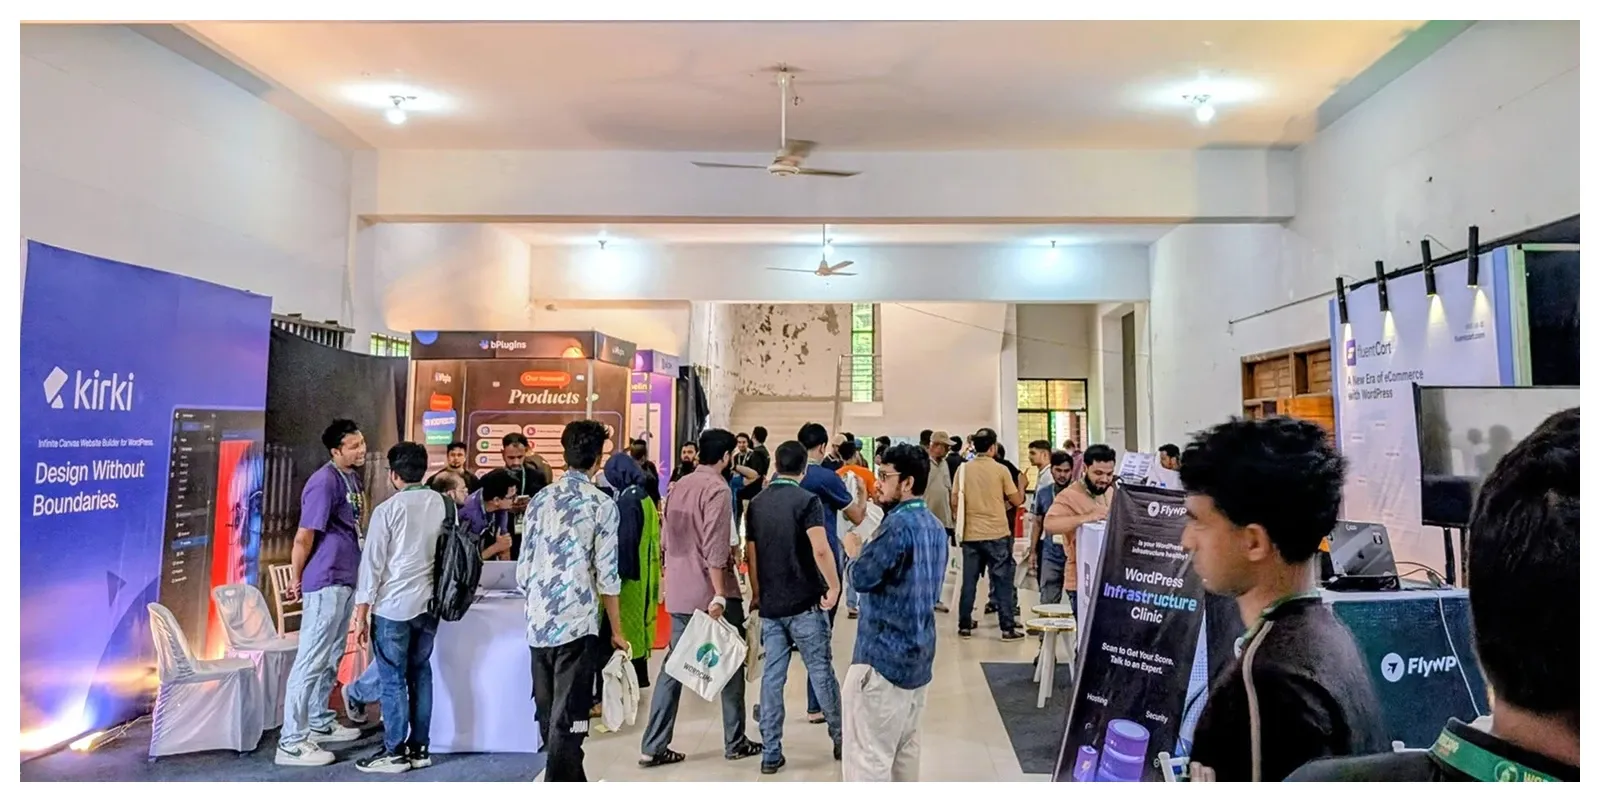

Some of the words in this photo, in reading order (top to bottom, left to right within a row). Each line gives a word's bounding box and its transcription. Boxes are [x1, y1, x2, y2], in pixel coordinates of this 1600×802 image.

[490, 339, 527, 351] bPlugins
[1365, 373, 1376, 385] Era
[1384, 369, 1424, 383] eCommerce
[74, 369, 135, 411] kirki
[508, 389, 580, 404] Products
[38, 439, 58, 448] Infinite
[59, 438, 79, 448] Canvas
[80, 438, 101, 447] Website
[35, 461, 89, 486] Design
[92, 459, 145, 481] Without
[32, 489, 119, 517] Boundaries.
[1155, 542, 1184, 551] WordPress
[1125, 567, 1184, 589] WordPress
[1103, 582, 1198, 613] Infrastructure
[1130, 606, 1163, 624] Clinic
[1101, 642, 1118, 653] Scan
[1118, 646, 1126, 655] to
[1126, 648, 1139, 658] Get
[1139, 650, 1154, 661] Your
[1154, 654, 1174, 666] Score.
[1110, 655, 1123, 666] Talk
[1124, 659, 1131, 667] to
[1131, 661, 1140, 669] an
[1140, 662, 1163, 675] Expert.
[1407, 655, 1458, 678] FlyWP
[1086, 693, 1109, 707] Hosting
[1145, 710, 1169, 725] Security
